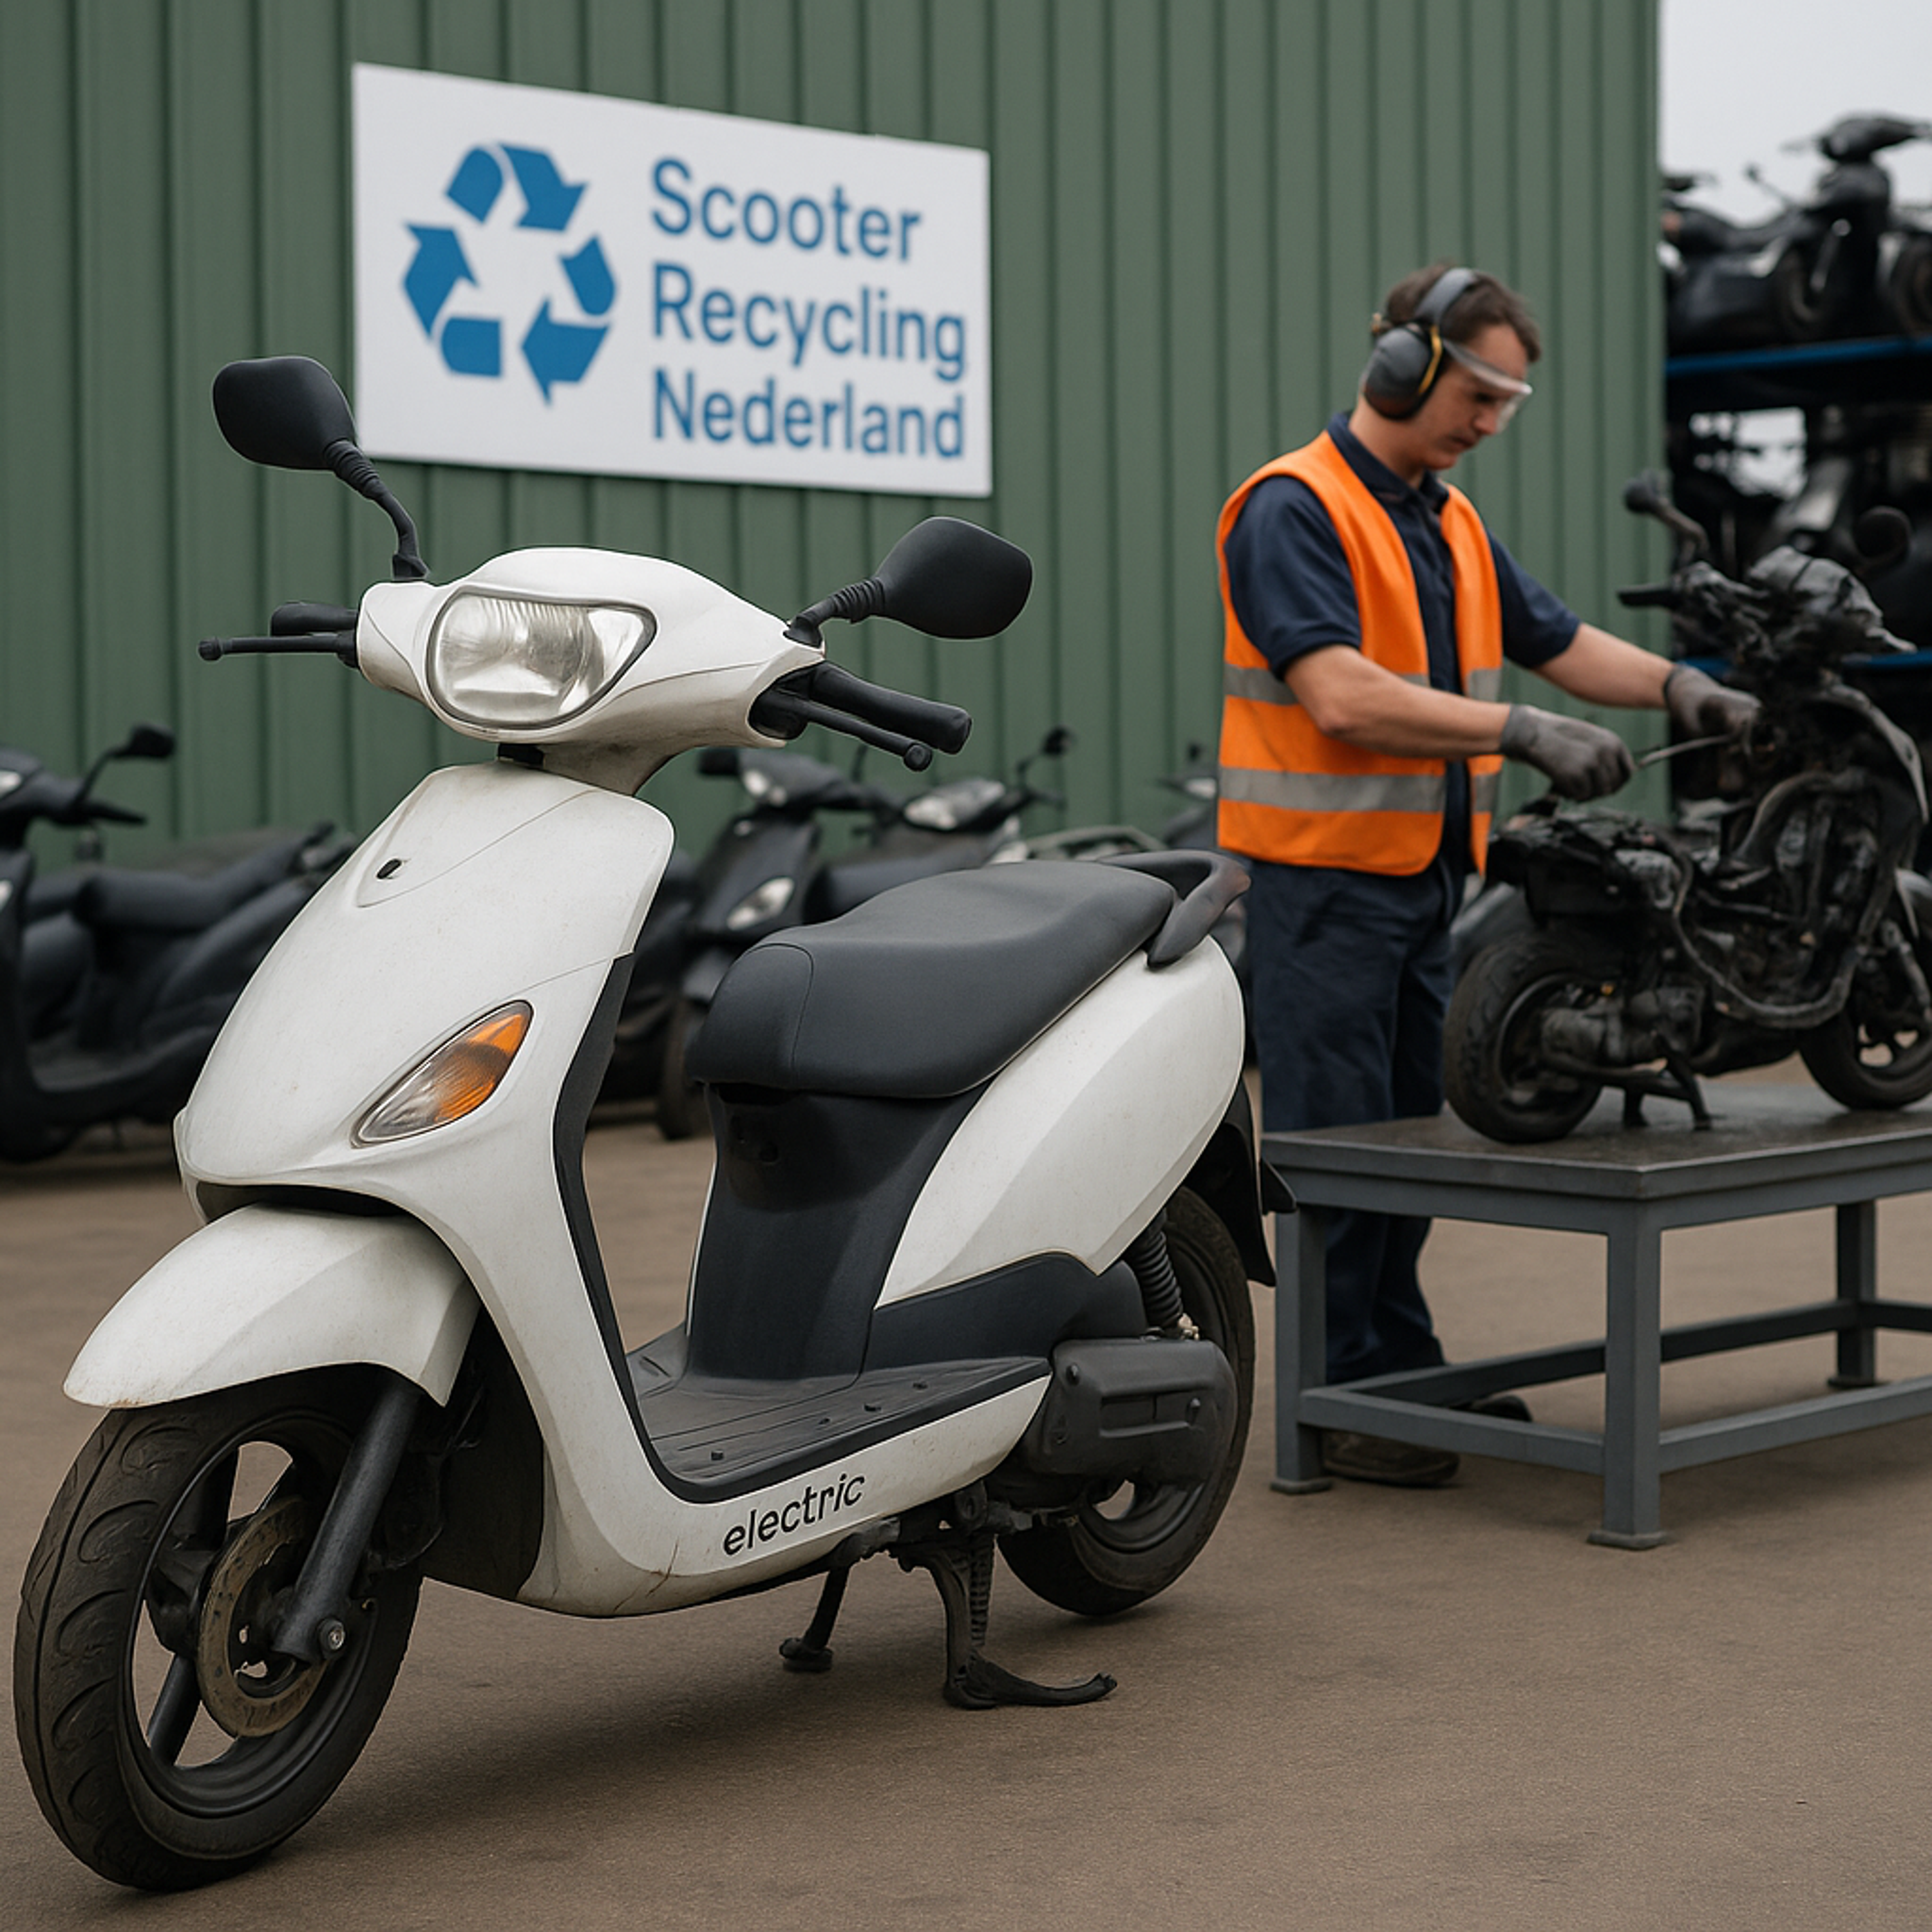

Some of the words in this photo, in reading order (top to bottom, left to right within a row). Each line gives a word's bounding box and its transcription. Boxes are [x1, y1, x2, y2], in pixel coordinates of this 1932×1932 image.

[650, 156, 921, 261] Scooter
[652, 261, 966, 384] Recycling
[652, 367, 965, 459] Nederland
[723, 1473, 866, 1556] electric
